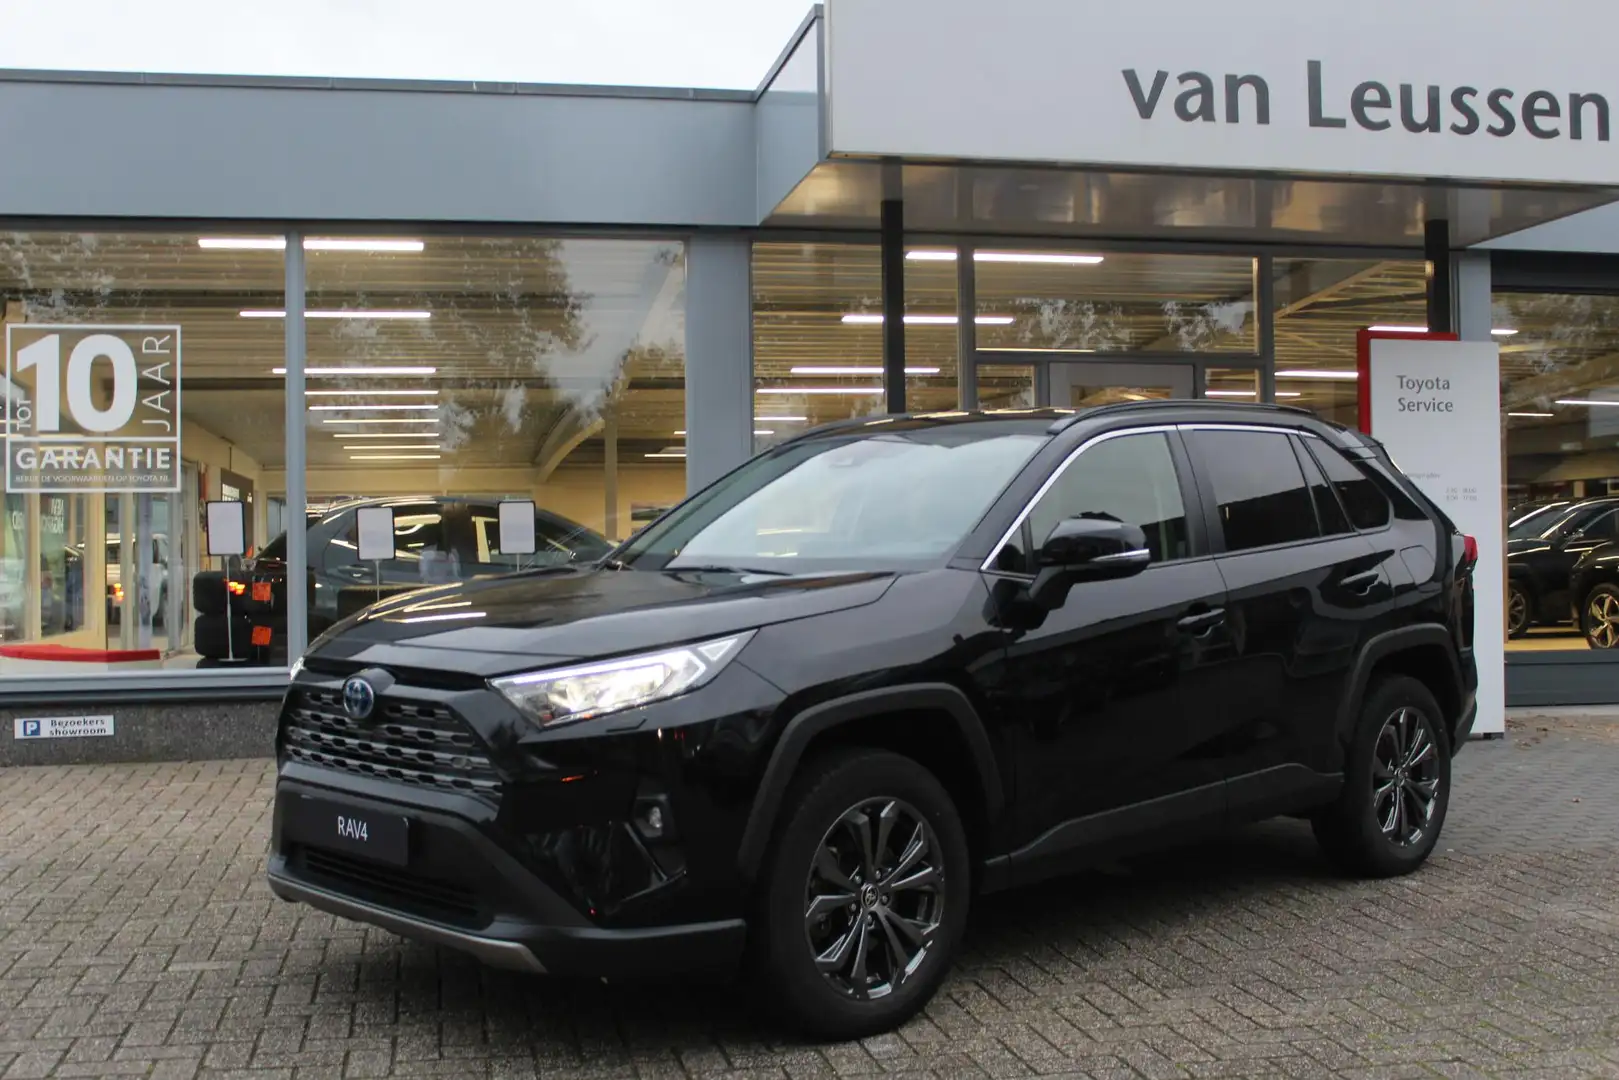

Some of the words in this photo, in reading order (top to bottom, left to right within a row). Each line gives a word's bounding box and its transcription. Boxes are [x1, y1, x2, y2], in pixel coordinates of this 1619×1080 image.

[1121, 68, 1270, 125] van
[1306, 60, 1610, 141] Leussen
[16, 333, 138, 432] 10
[141, 334, 171, 432] JAAR
[1396, 375, 1450, 394] Toyota
[16, 397, 31, 431] TOT
[1398, 397, 1454, 412] Service
[16, 447, 170, 469] GARANTIE
[49, 728, 106, 736] showroom
[50, 718, 105, 728] Bezoekers
[337, 815, 368, 841] RAV4
